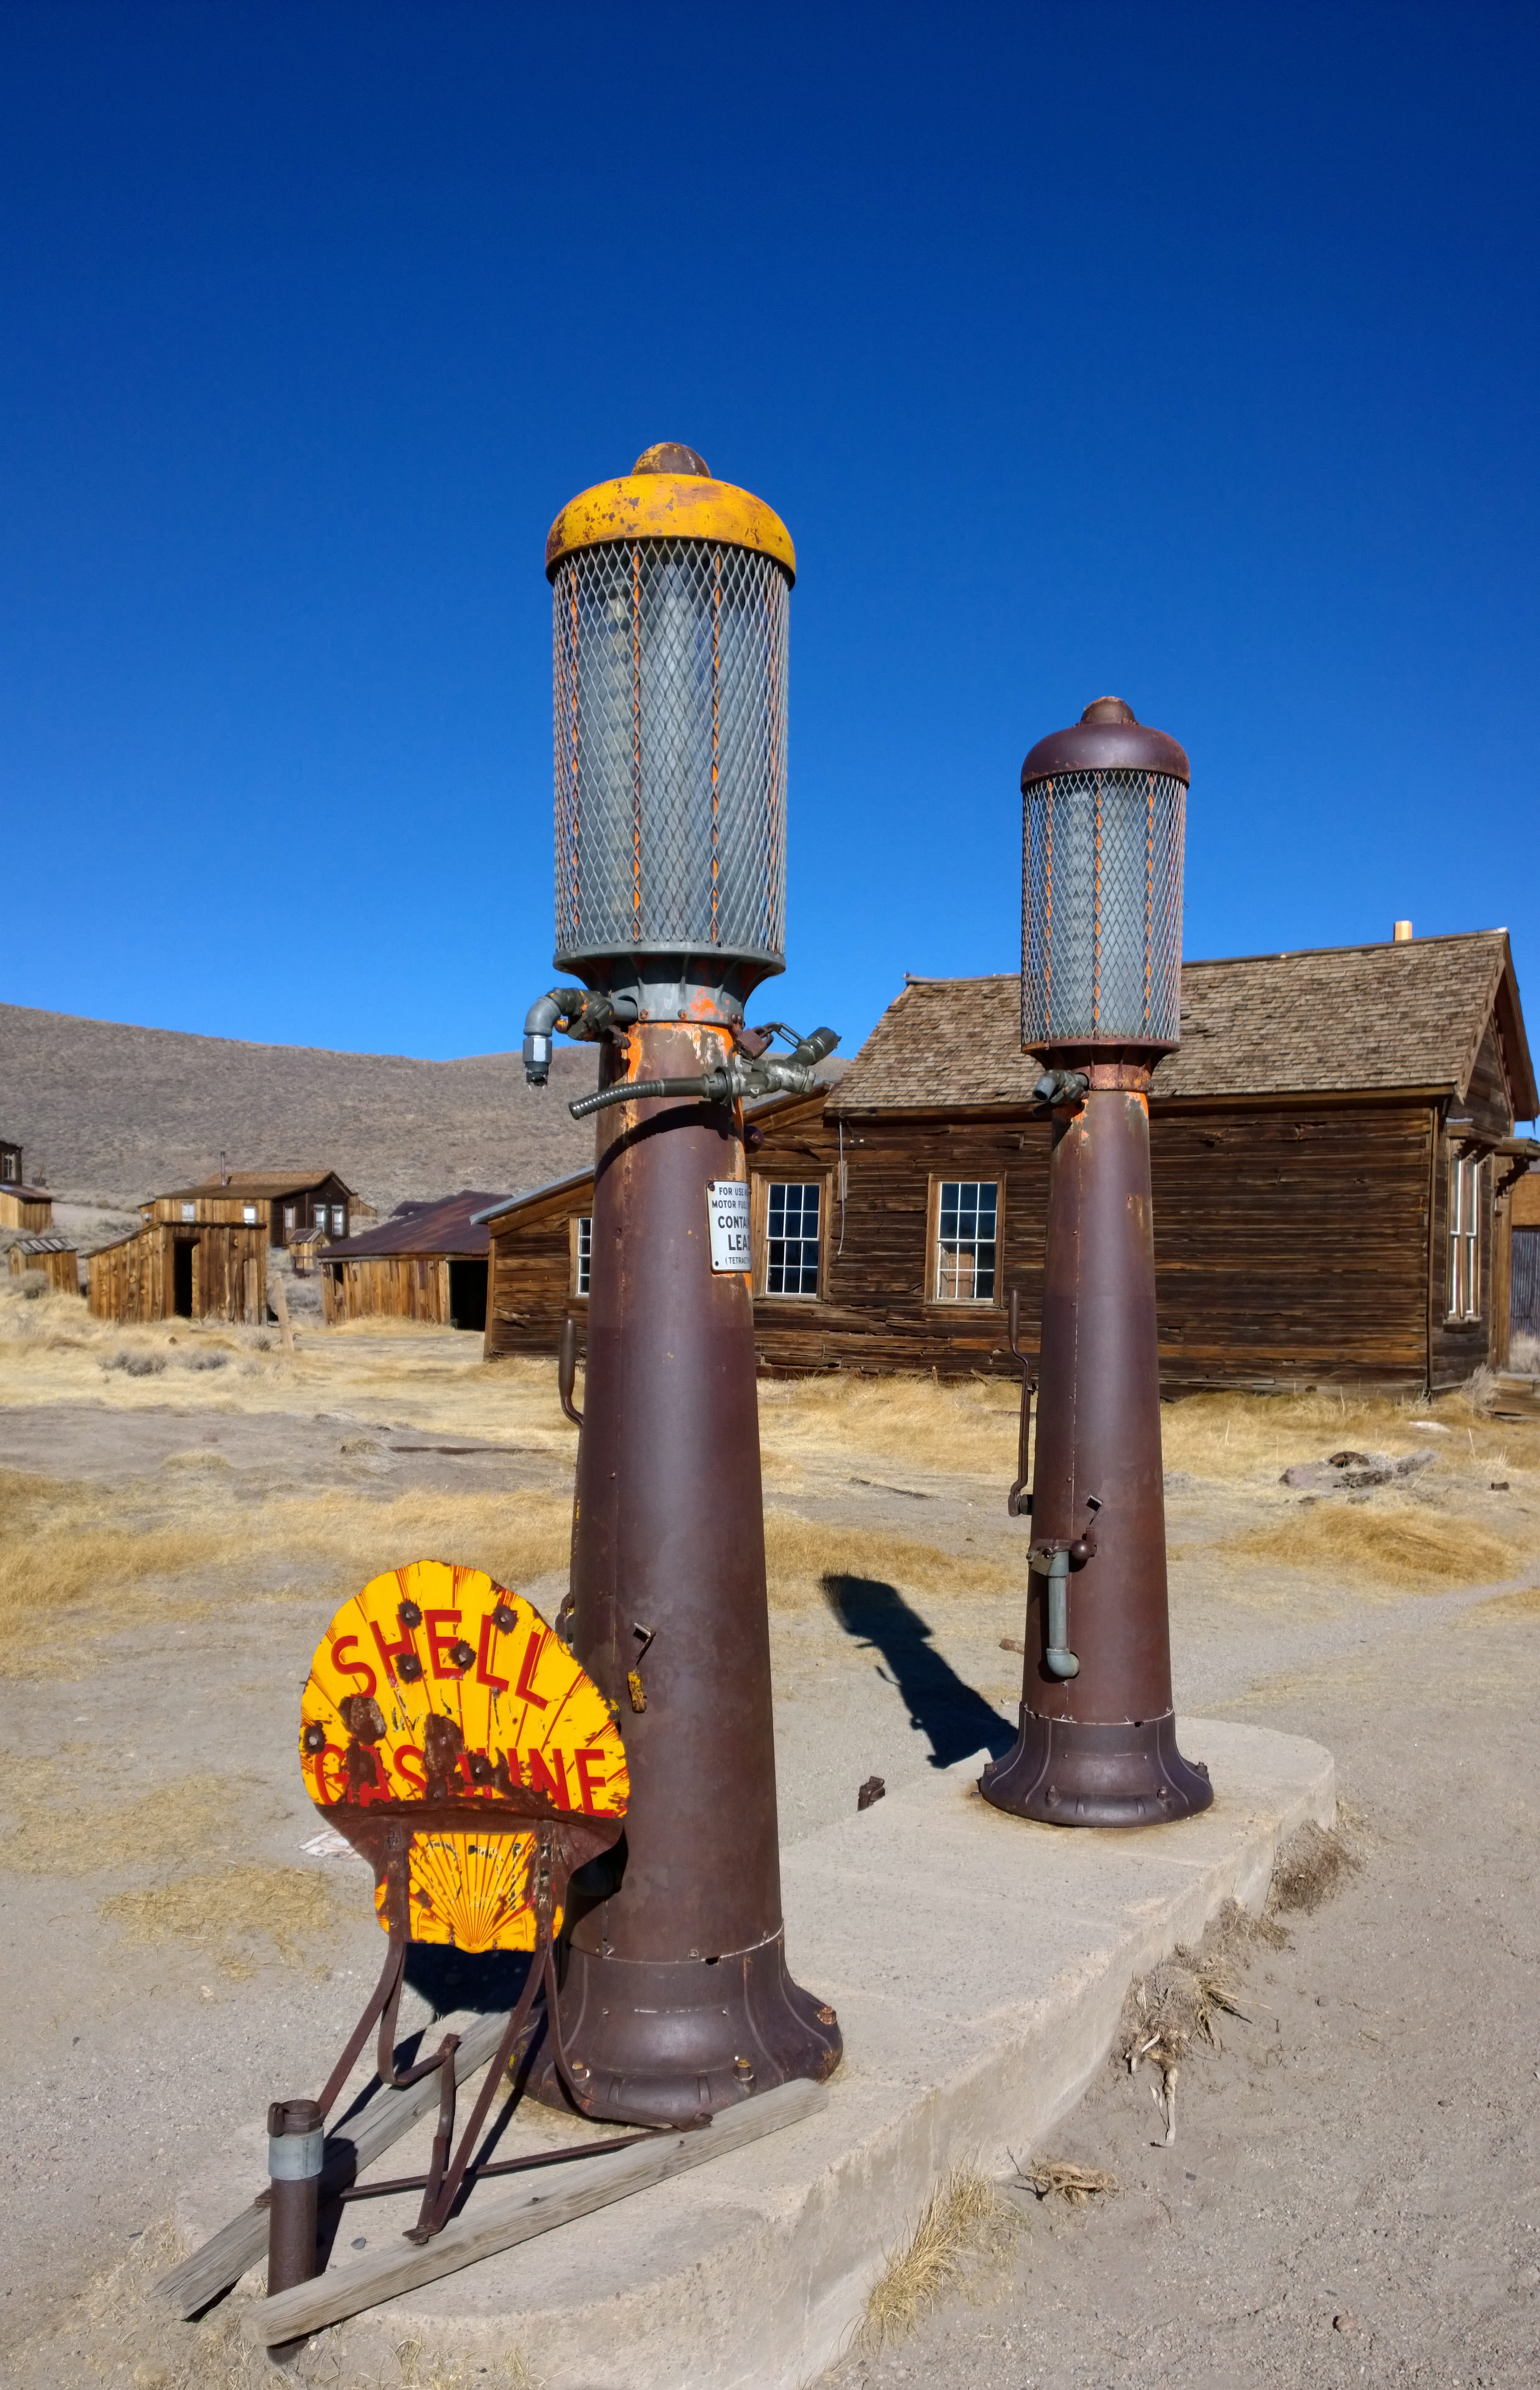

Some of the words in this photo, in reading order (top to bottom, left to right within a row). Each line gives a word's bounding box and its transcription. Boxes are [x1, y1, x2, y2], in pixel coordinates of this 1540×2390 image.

[719, 1187, 732, 1196] FOR
[735, 1188, 743, 1196] USE
[712, 1200, 736, 1208] MOTOR
[738, 1200, 747, 1209] FUEL
[728, 1234, 751, 1251] LEAD
[330, 1609, 549, 1710] SHELL
[315, 1743, 614, 1818] GASINE
